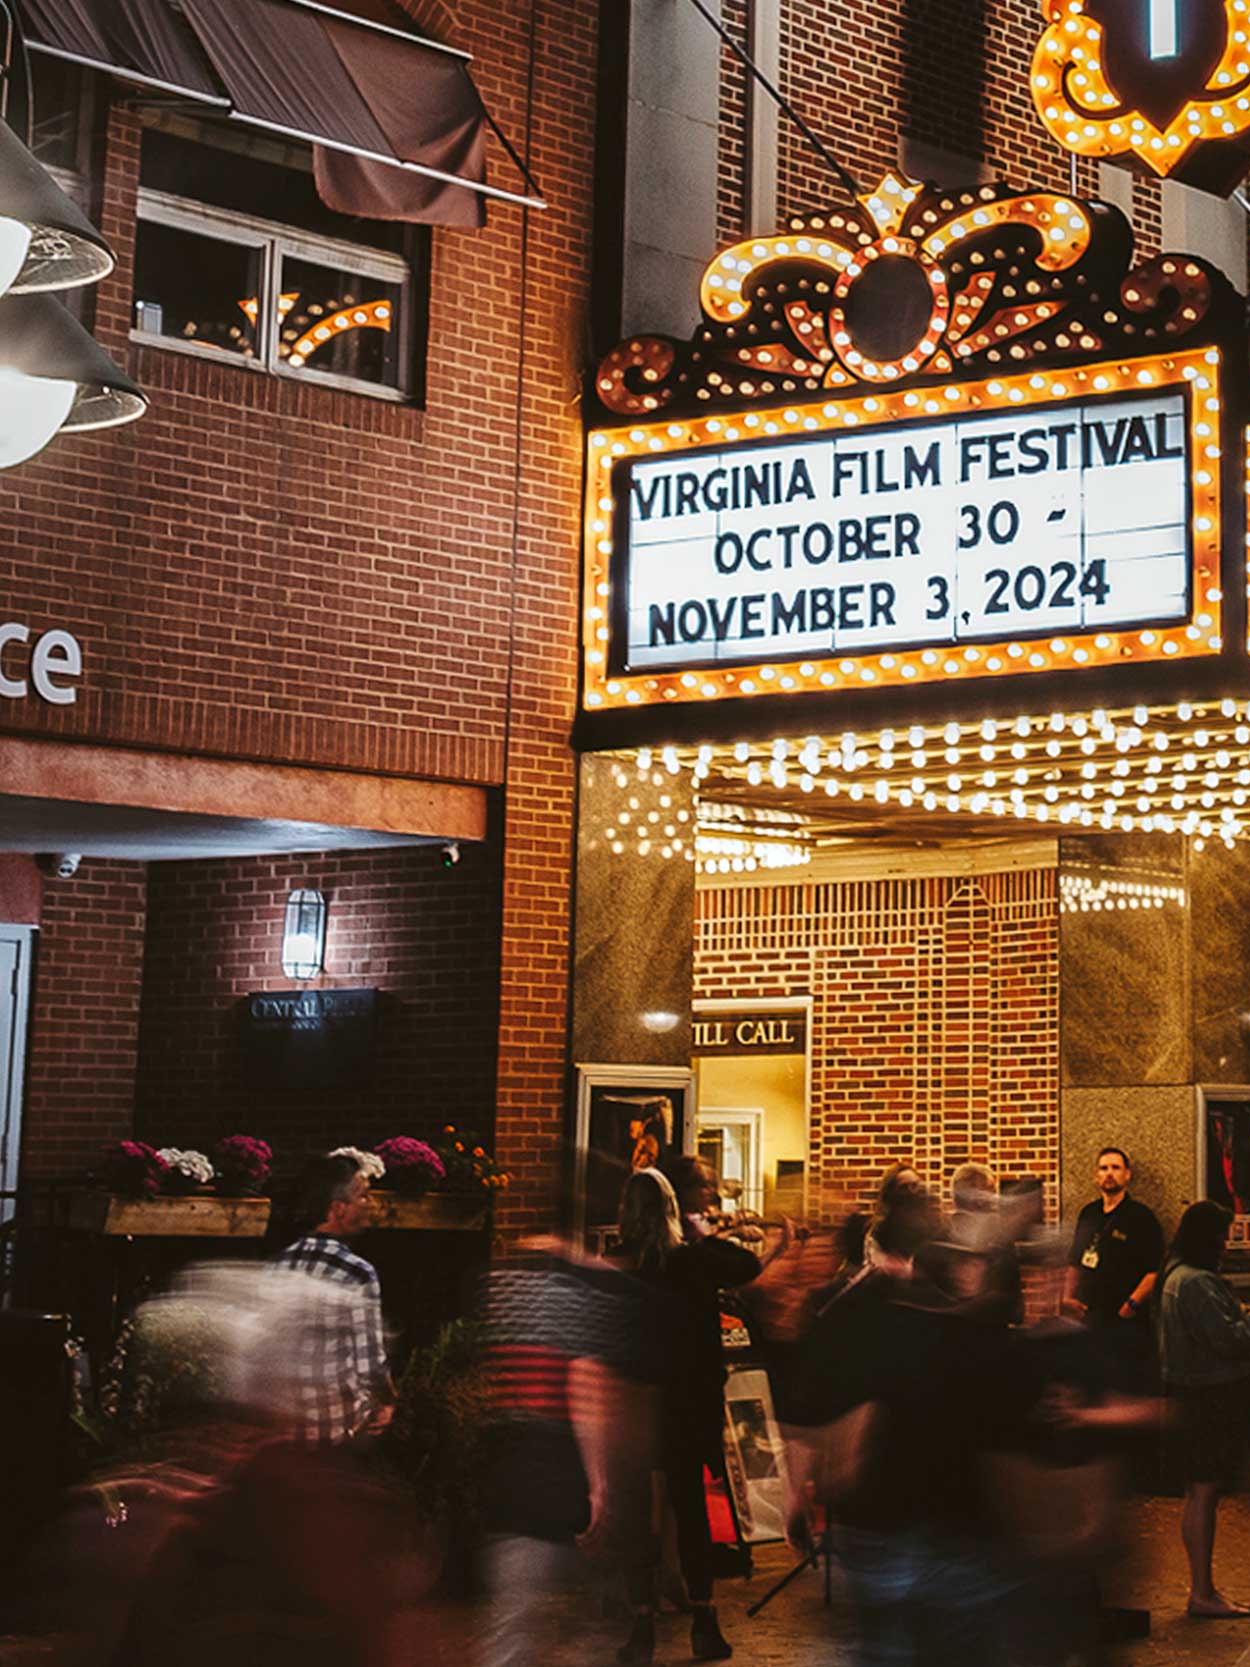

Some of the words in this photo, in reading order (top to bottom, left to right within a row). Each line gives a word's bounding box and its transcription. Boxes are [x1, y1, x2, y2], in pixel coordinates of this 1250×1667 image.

[633, 458, 816, 521] VIRGINIA
[832, 441, 942, 499] FILM
[959, 413, 1183, 483] FESTIVAL
[714, 512, 922, 575] OCTOBER
[959, 500, 1020, 549] 30
[648, 581, 897, 647] NOVEMBER
[691, 1022, 728, 1046] ILL
[736, 1020, 795, 1045] CALL
